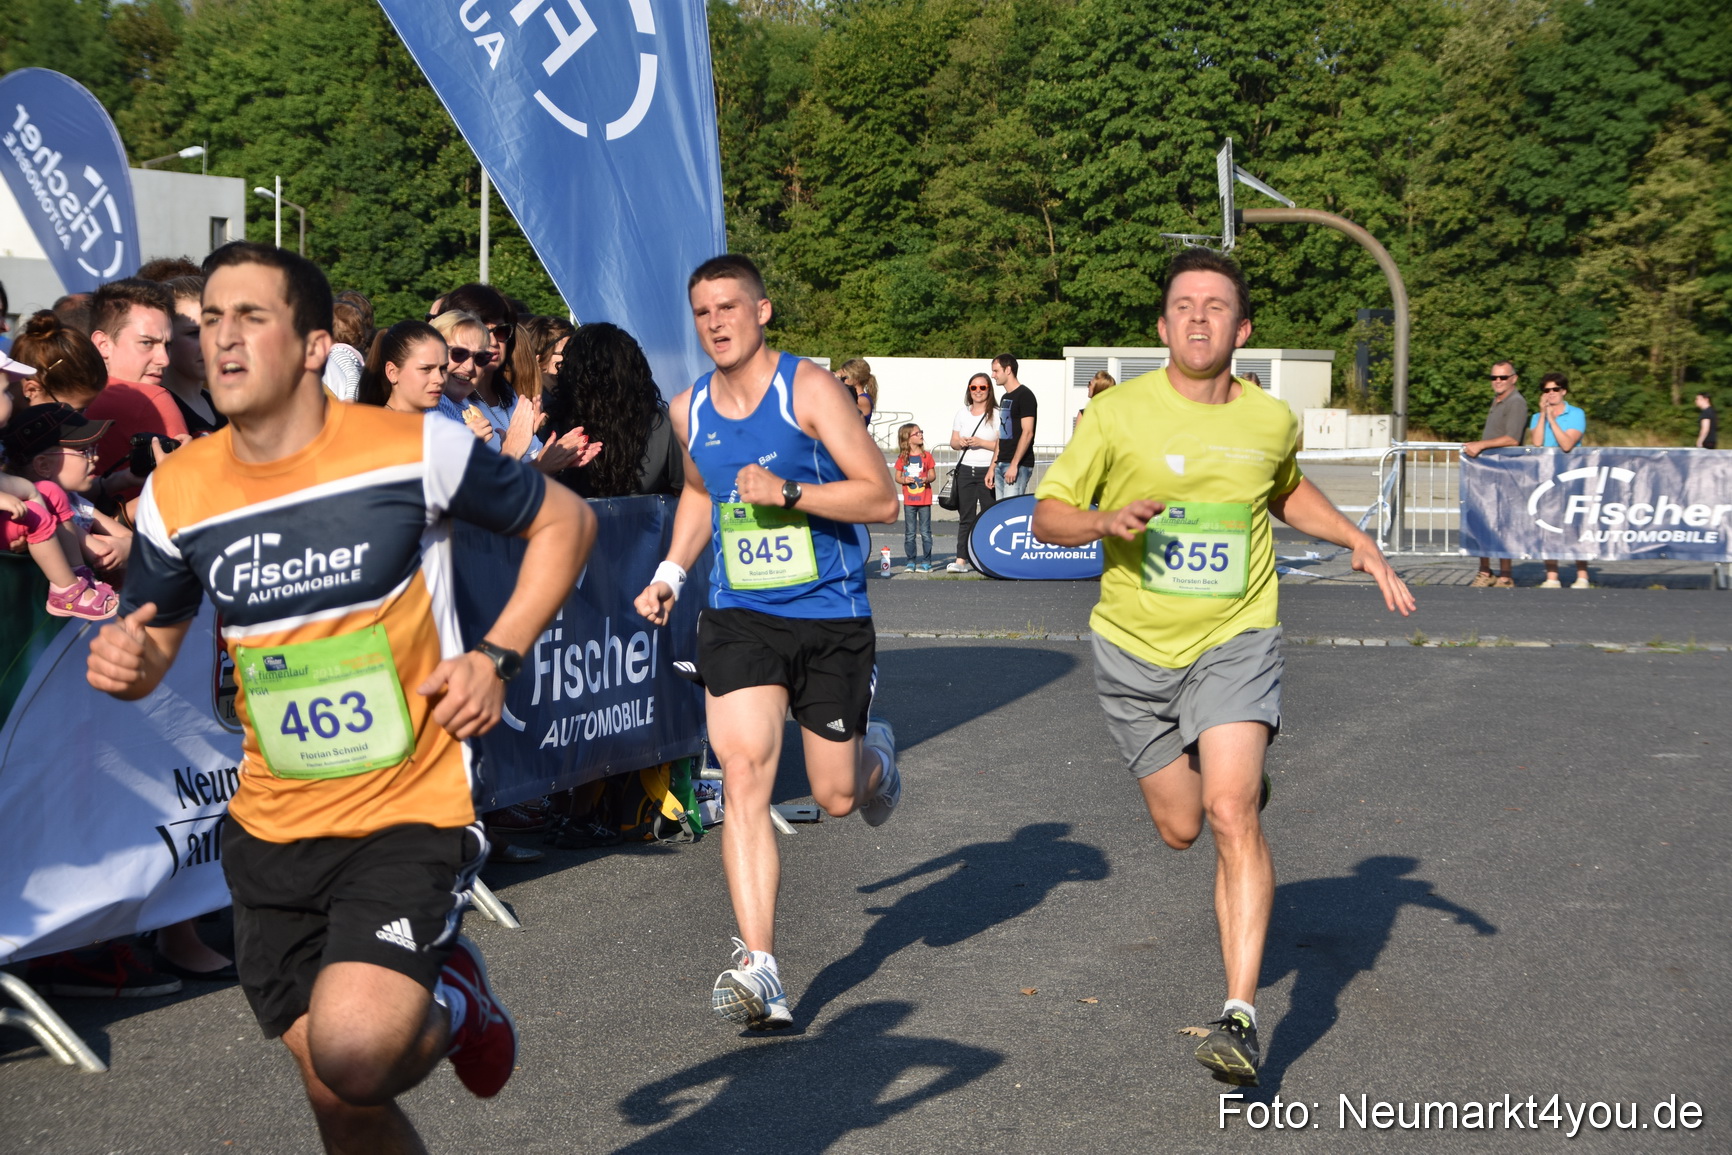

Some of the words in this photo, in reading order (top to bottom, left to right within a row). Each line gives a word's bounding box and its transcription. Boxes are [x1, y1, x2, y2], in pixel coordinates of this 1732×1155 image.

[758, 451, 777, 465] Bau
[1564, 495, 1732, 526] Fischer
[737, 535, 793, 565] 845
[1578, 530, 1719, 544] AUTOMOBILE
[233, 541, 370, 592] Fischer
[1021, 551, 1097, 560] AUTOMOBILE
[1165, 540, 1229, 572] 655
[247, 568, 361, 605] AUTOMOBILE
[769, 568, 786, 576] Braun
[1172, 576, 1201, 584] Thorsten
[280, 690, 374, 742] 463
[539, 695, 654, 750] AUTOMOBILE
[300, 749, 332, 761] Florian
[332, 742, 368, 756] Schmid
